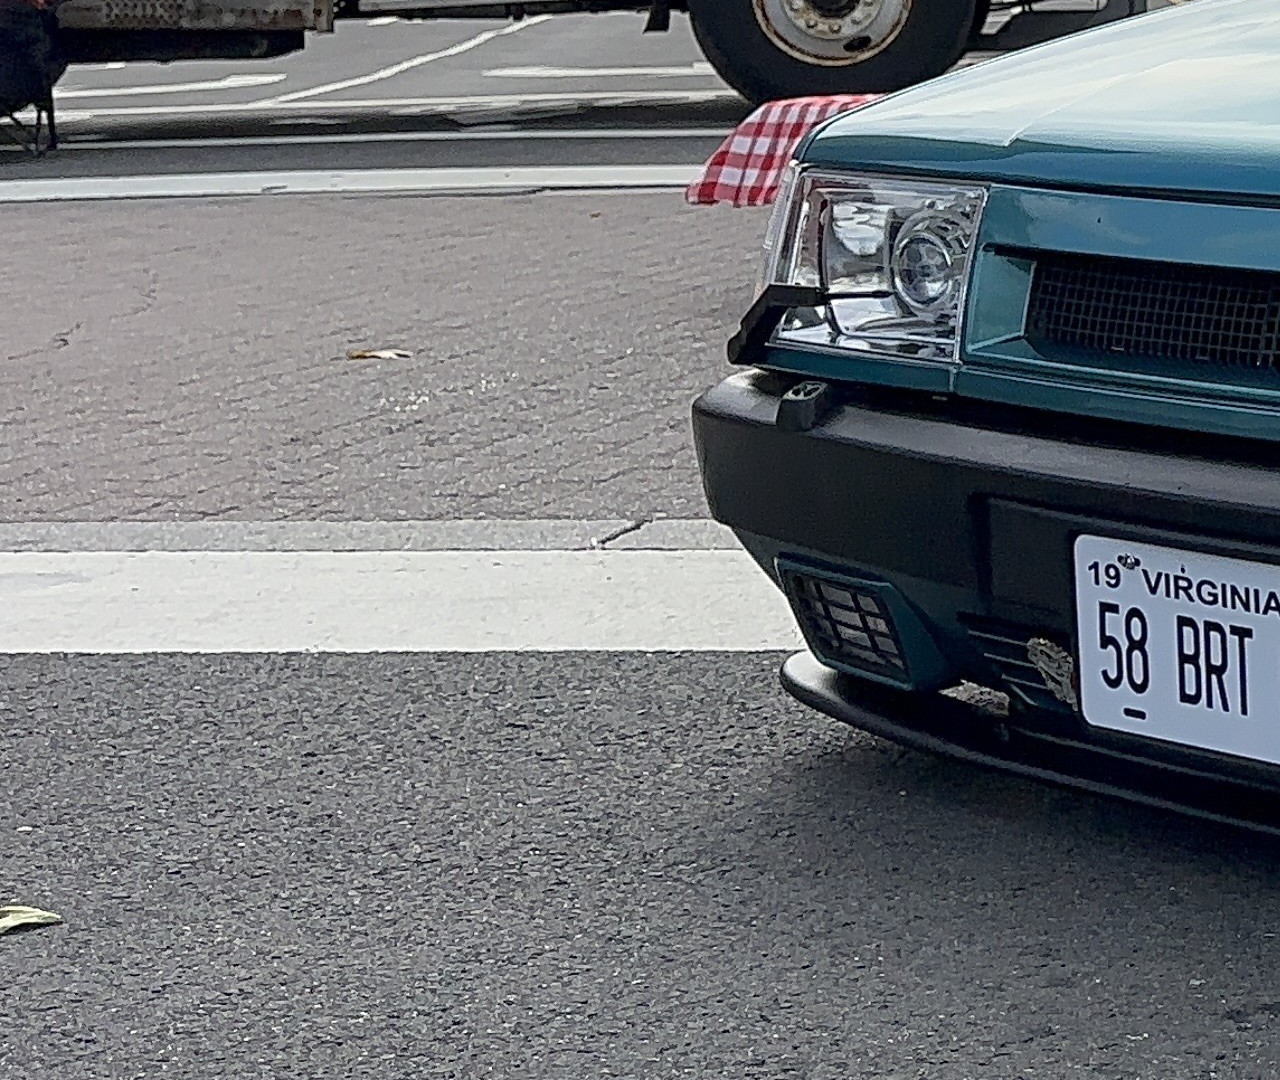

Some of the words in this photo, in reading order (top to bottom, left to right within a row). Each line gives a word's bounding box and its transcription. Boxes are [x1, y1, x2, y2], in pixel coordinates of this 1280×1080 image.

[1088, 561, 1121, 589] 19
[1098, 600, 1150, 694] 58
[1177, 614, 1254, 716] BRT
